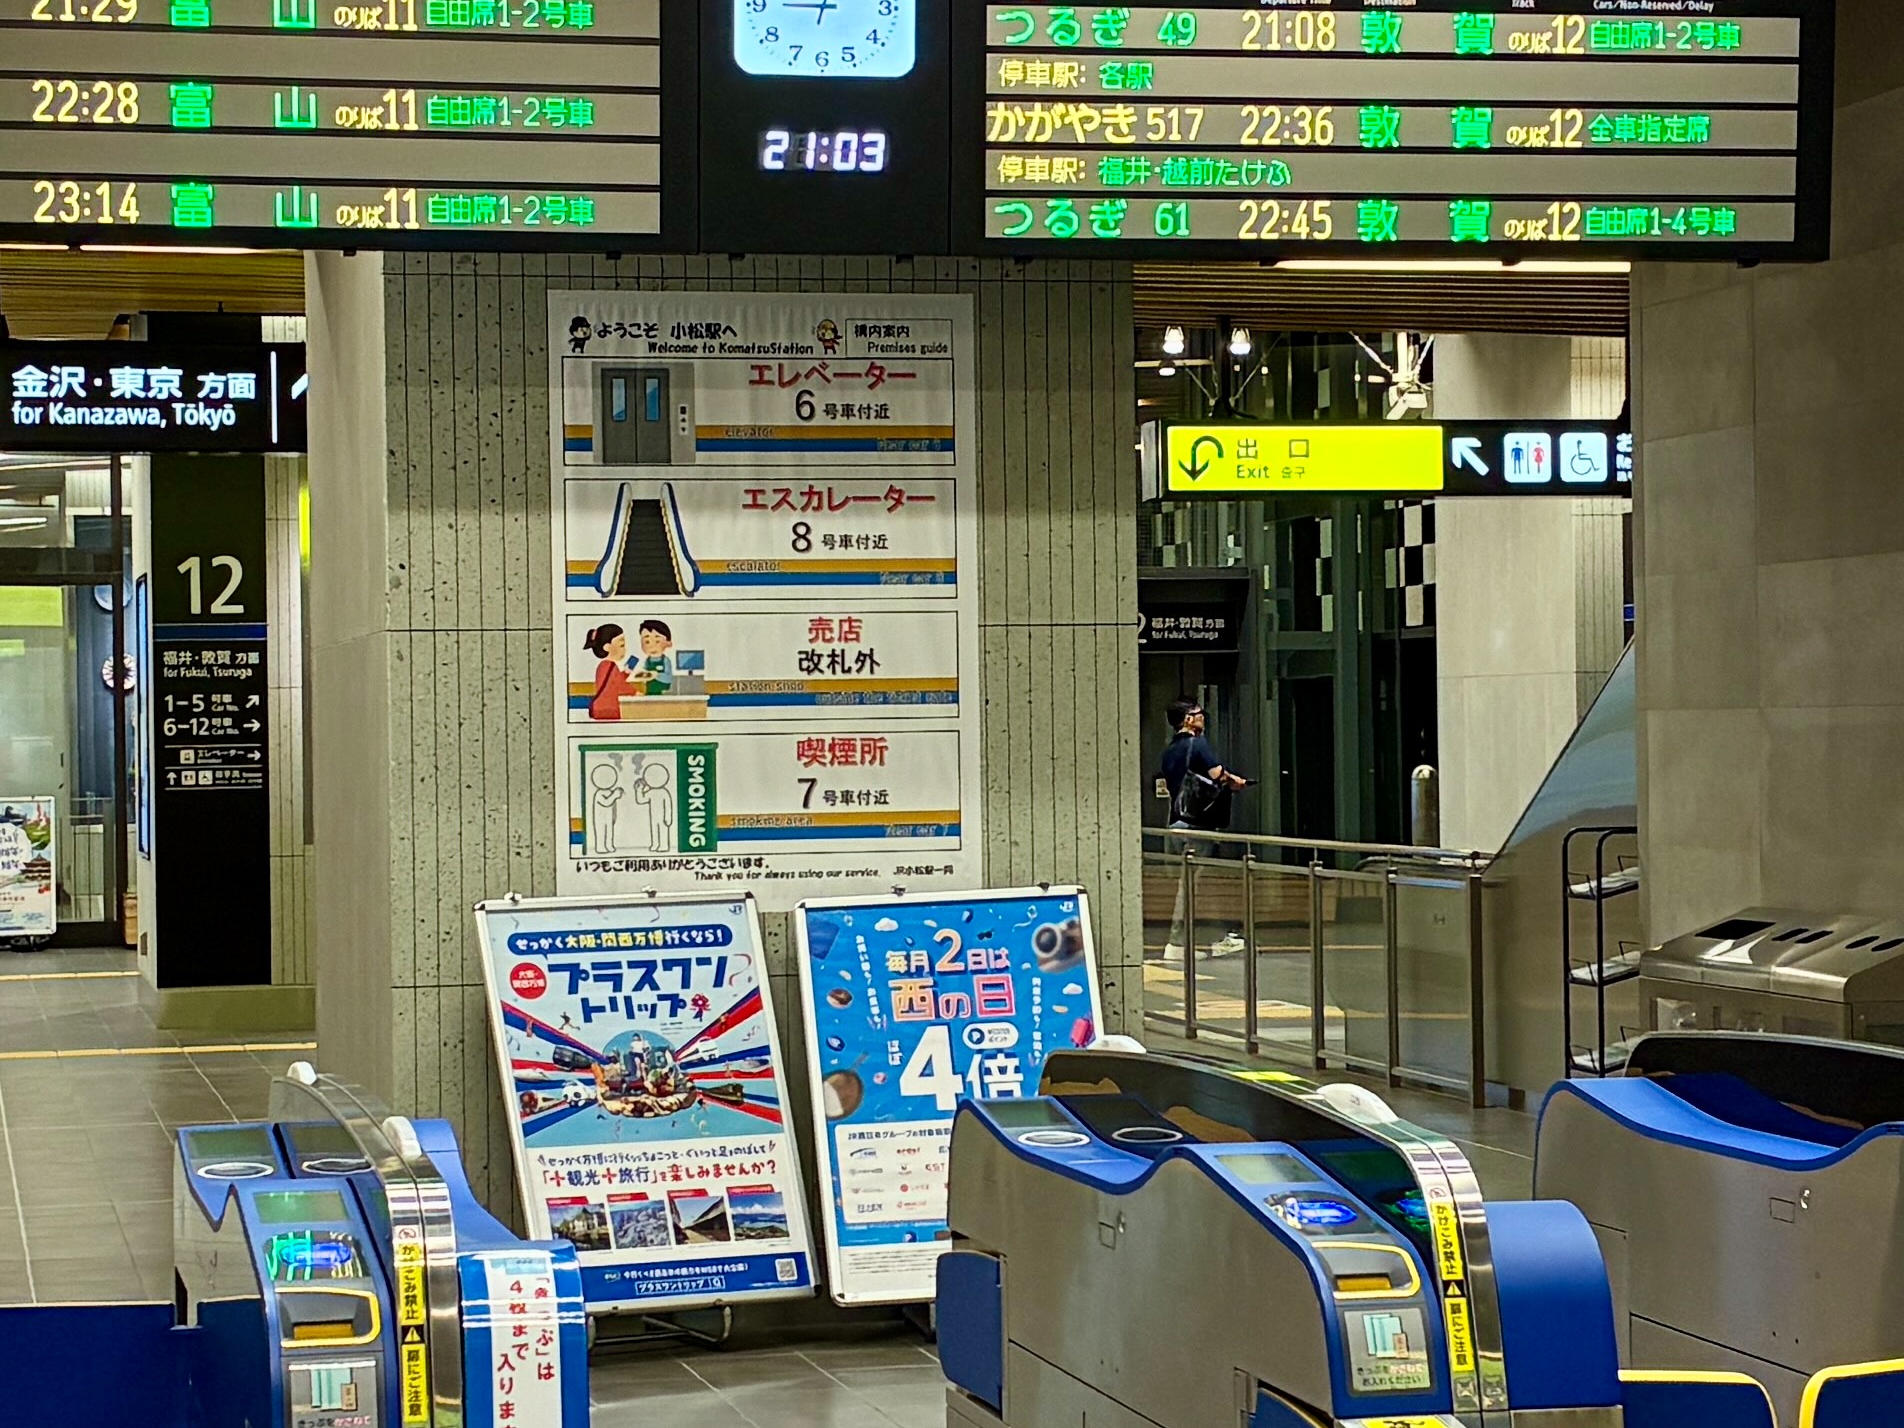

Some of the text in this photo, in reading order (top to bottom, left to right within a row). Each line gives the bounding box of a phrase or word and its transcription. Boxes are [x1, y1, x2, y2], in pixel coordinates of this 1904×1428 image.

[878, 0, 892, 16] 3
[764, 27, 779, 42] 8
[866, 29, 881, 44] 4
[996, 7, 1130, 47] つるぎ
[1157, 12, 1196, 46] 49
[1241, 10, 1336, 51] 21:08
[1590, 22, 1740, 50] 自由席1-2号車
[789, 45, 803, 61] 7
[815, 51, 829, 67] 6
[841, 47, 856, 62] 5
[1099, 61, 1153, 90] 各駅
[32, 80, 138, 123] 22:28
[426, 96, 593, 128] 自由席1-2号車
[986, 104, 1137, 143] かがやき
[1146, 108, 1204, 141] 517
[1240, 106, 1334, 145] 22:36
[1588, 114, 1711, 144] 全車指定席
[763, 130, 886, 171] 21:03
[33, 181, 139, 224] 23:14
[427, 196, 593, 226] 自由席1-2号車
[994, 199, 1127, 237] つるぎ
[1155, 202, 1190, 236] 61
[1239, 200, 1332, 239] 22:45
[1586, 207, 1735, 236] 自由席1-4号車
[597, 323, 737, 339] ようこそ 小松駅へ
[647, 342, 697, 354] Welcome
[703, 342, 715, 354] to
[868, 342, 947, 355] Premises guide
[11, 365, 183, 399] 金沢・東京
[197, 372, 256, 400] 方面
[749, 362, 916, 389] エレベーター
[12, 402, 236, 430] for Kanazawa, Tōkyō
[796, 390, 890, 421] 6 号車付近
[1236, 438, 1310, 460] 出口
[1236, 465, 1270, 479] Exit
[742, 485, 936, 512] エスカレーター
[792, 522, 888, 553] 8 号車付近
[177, 555, 244, 614] 12
[808, 617, 863, 643] 売店
[798, 648, 881, 675] 改札外
[797, 737, 888, 768] 喫煙所
[688, 753, 706, 849] SMOKING
[797, 778, 889, 809] 7 号車付近
[886, 928, 1010, 973] 毎月2日は
[548, 955, 728, 994] プラスワン
[581, 993, 686, 1023] トリップ
[888, 973, 1015, 1021] 西の日
